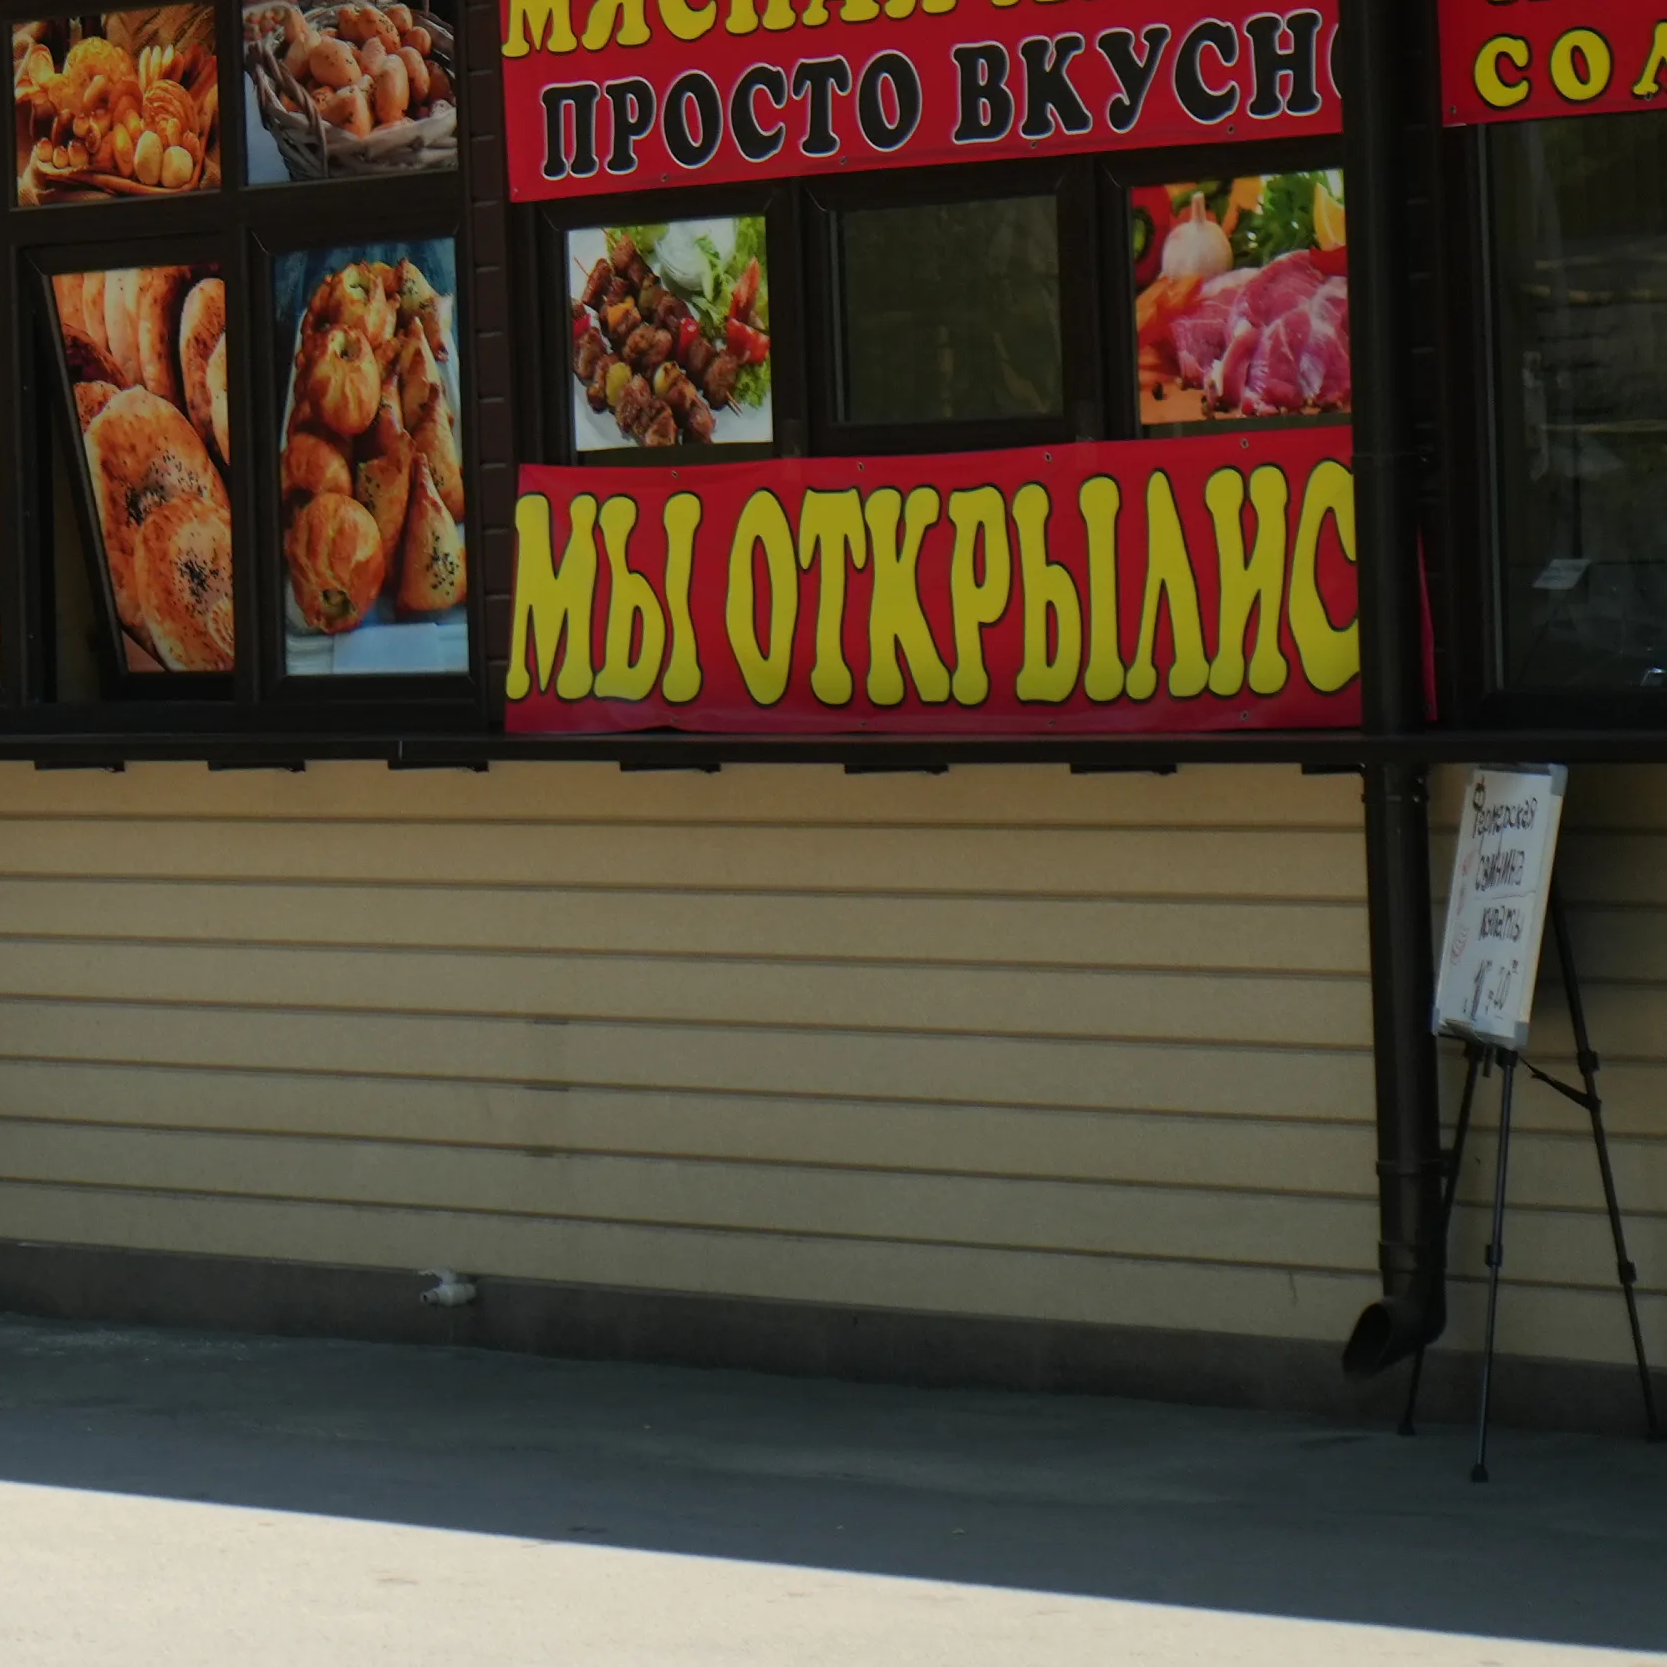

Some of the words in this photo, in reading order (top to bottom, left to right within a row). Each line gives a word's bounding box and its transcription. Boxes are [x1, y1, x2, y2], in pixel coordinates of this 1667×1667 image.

[540, 49, 922, 181] ПРОСТО
[951, 8, 1342, 147] ВКУСН
[505, 491, 702, 703] МЫ
[725, 458, 1360, 706] ОТКРЫЛИС
